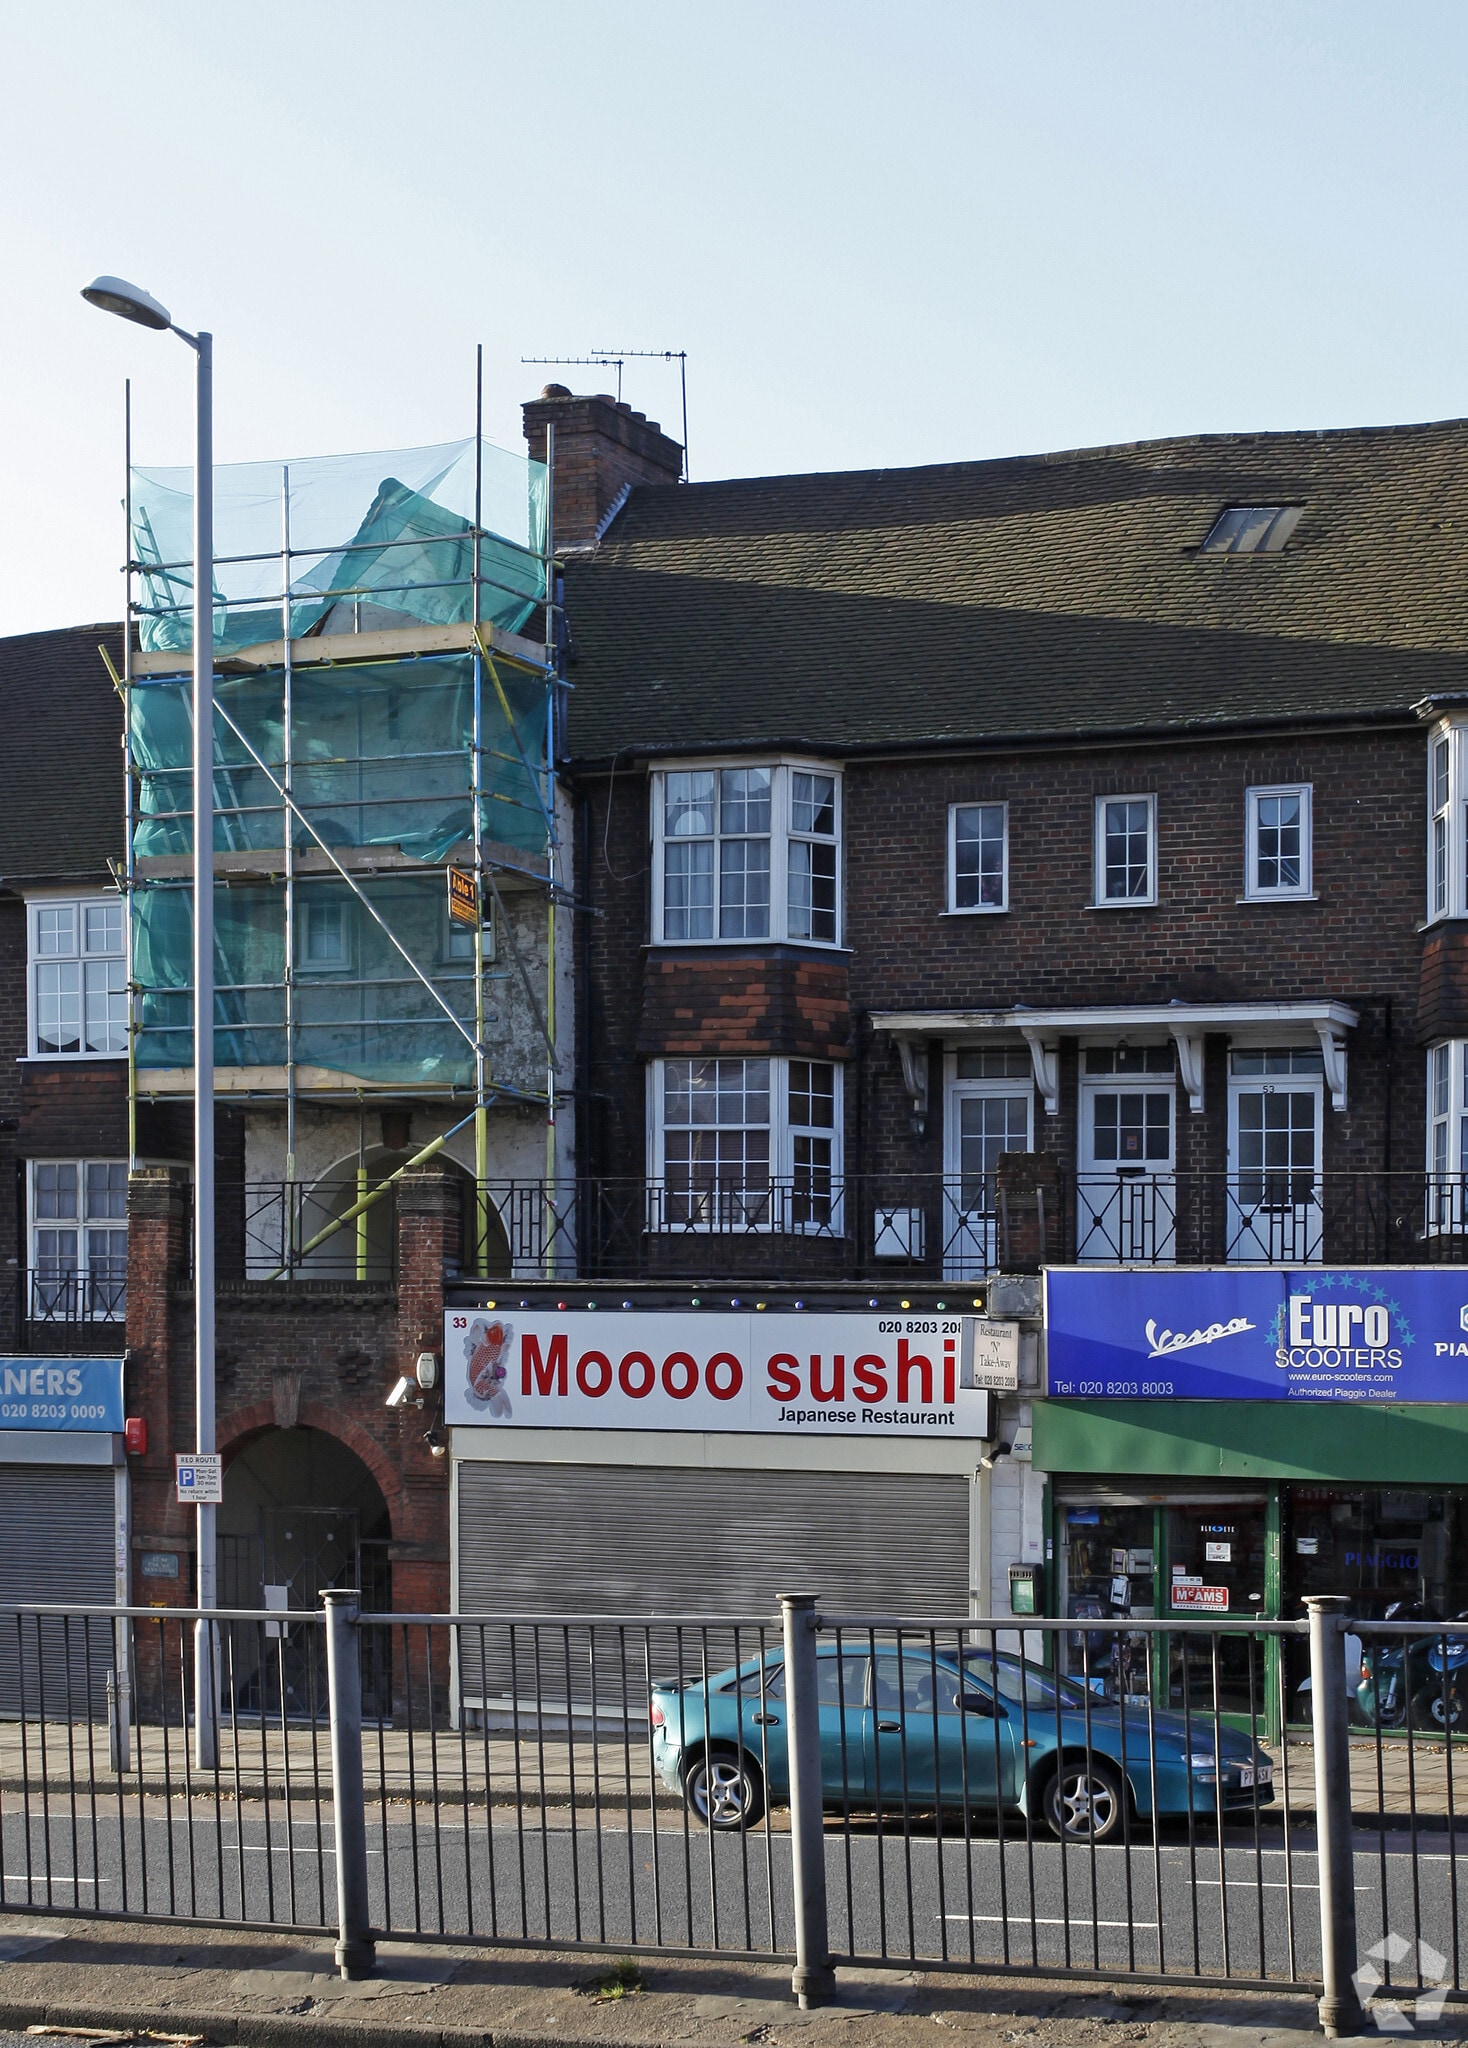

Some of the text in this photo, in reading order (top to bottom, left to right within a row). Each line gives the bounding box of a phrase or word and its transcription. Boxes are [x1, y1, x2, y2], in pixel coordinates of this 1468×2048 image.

[453, 1317, 467, 1328] 33
[879, 1321, 902, 1333] 020
[906, 1321, 938, 1334] 8203
[1289, 1295, 1389, 1348] Euro
[980, 1323, 1012, 1339] Restaurant
[1145, 1317, 1256, 1359] Vespa
[1434, 1342, 1468, 1357] PIA
[1275, 1348, 1403, 1369] SCOOTERS
[521, 1334, 955, 1404] Moooo sushi
[0, 1368, 83, 1396] NERS
[1288, 1373, 1393, 1382] www.euro-scooters.com
[1054, 1381, 1174, 1395] Tel: 020 8203 8003
[1288, 1388, 1397, 1399] Authorized Piaggio Dealer
[1, 1404, 106, 1419] 020 8203 0009
[779, 1407, 955, 1425] Japanese Restaurant
[182, 1470, 193, 1485] P
[1345, 1552, 1418, 1569] PIAGGIO
